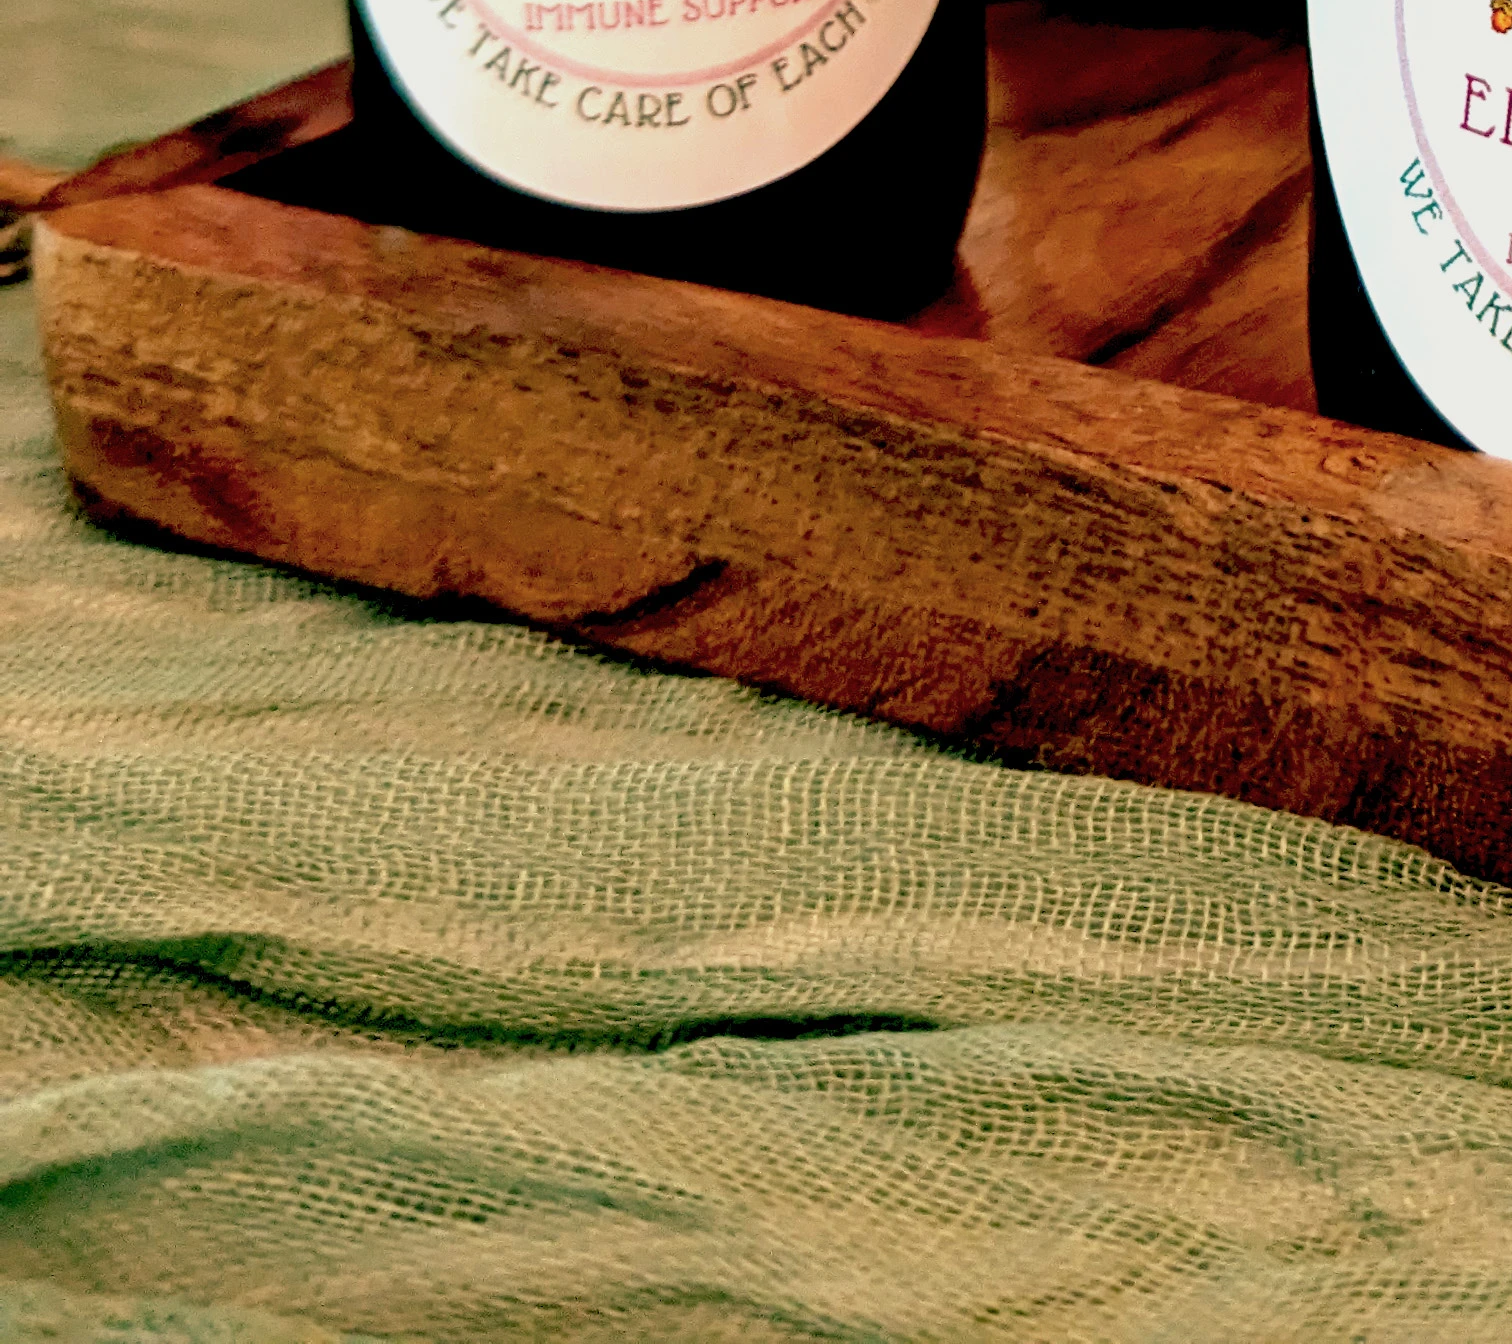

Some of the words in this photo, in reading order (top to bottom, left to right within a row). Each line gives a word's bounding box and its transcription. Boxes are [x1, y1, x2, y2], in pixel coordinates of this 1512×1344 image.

[467, 22, 563, 111] TAKE
[576, 85, 692, 129] CARE
[705, 72, 760, 119] OF
[773, 1, 869, 94] EACH
[1398, 155, 1445, 237] WE
